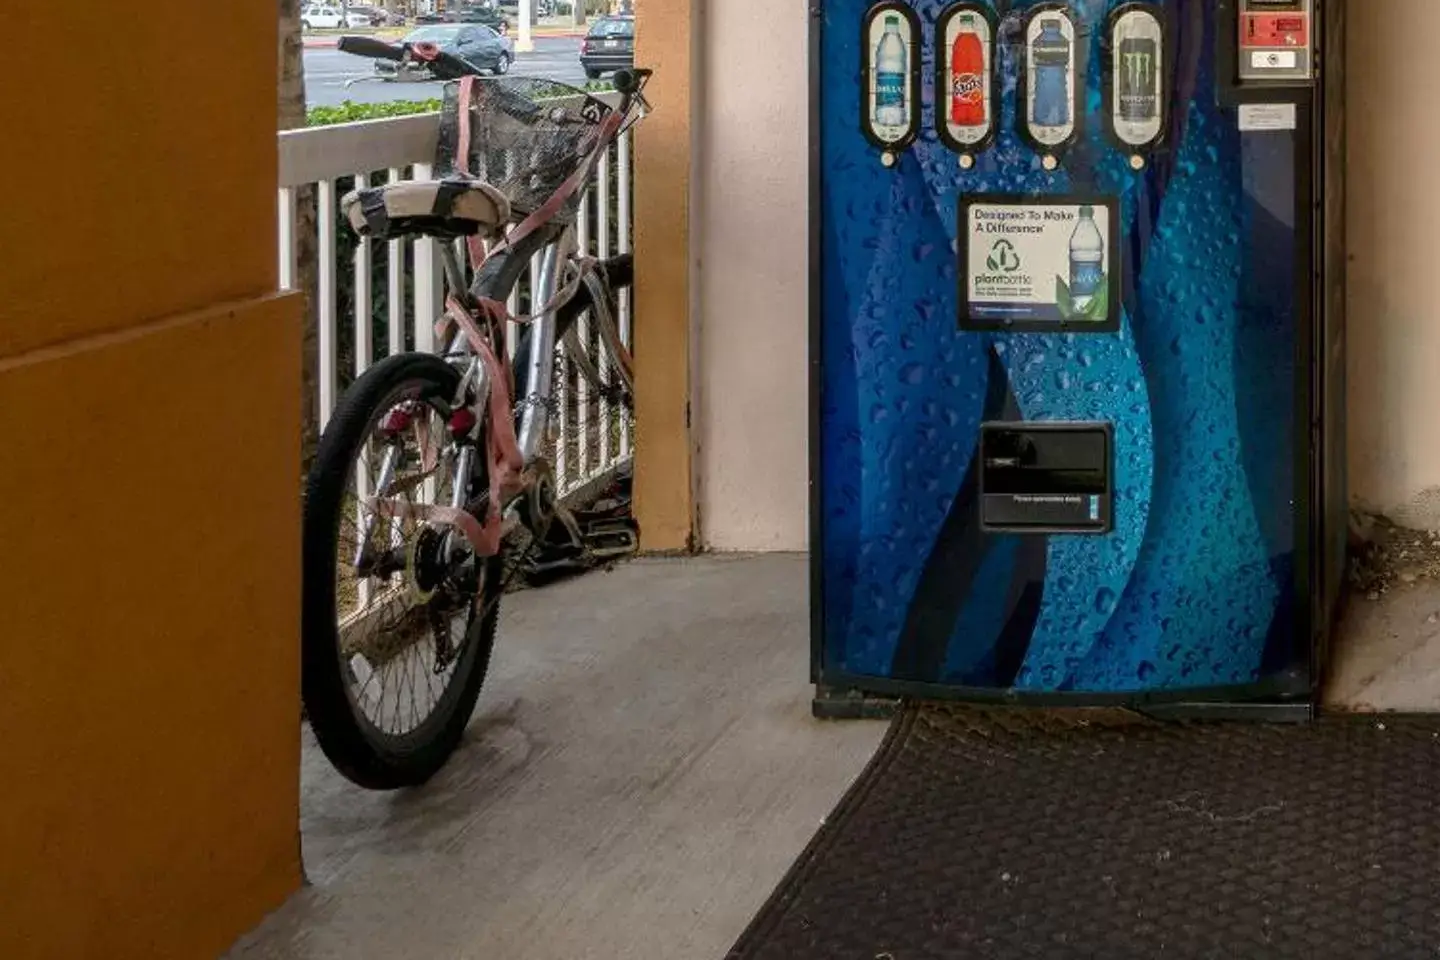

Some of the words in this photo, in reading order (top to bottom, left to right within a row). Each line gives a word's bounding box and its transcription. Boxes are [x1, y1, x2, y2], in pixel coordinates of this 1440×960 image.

[975, 209, 1025, 220] Designed
[1027, 210, 1041, 220] To
[1043, 210, 1074, 220] Make
[975, 223, 984, 233] A
